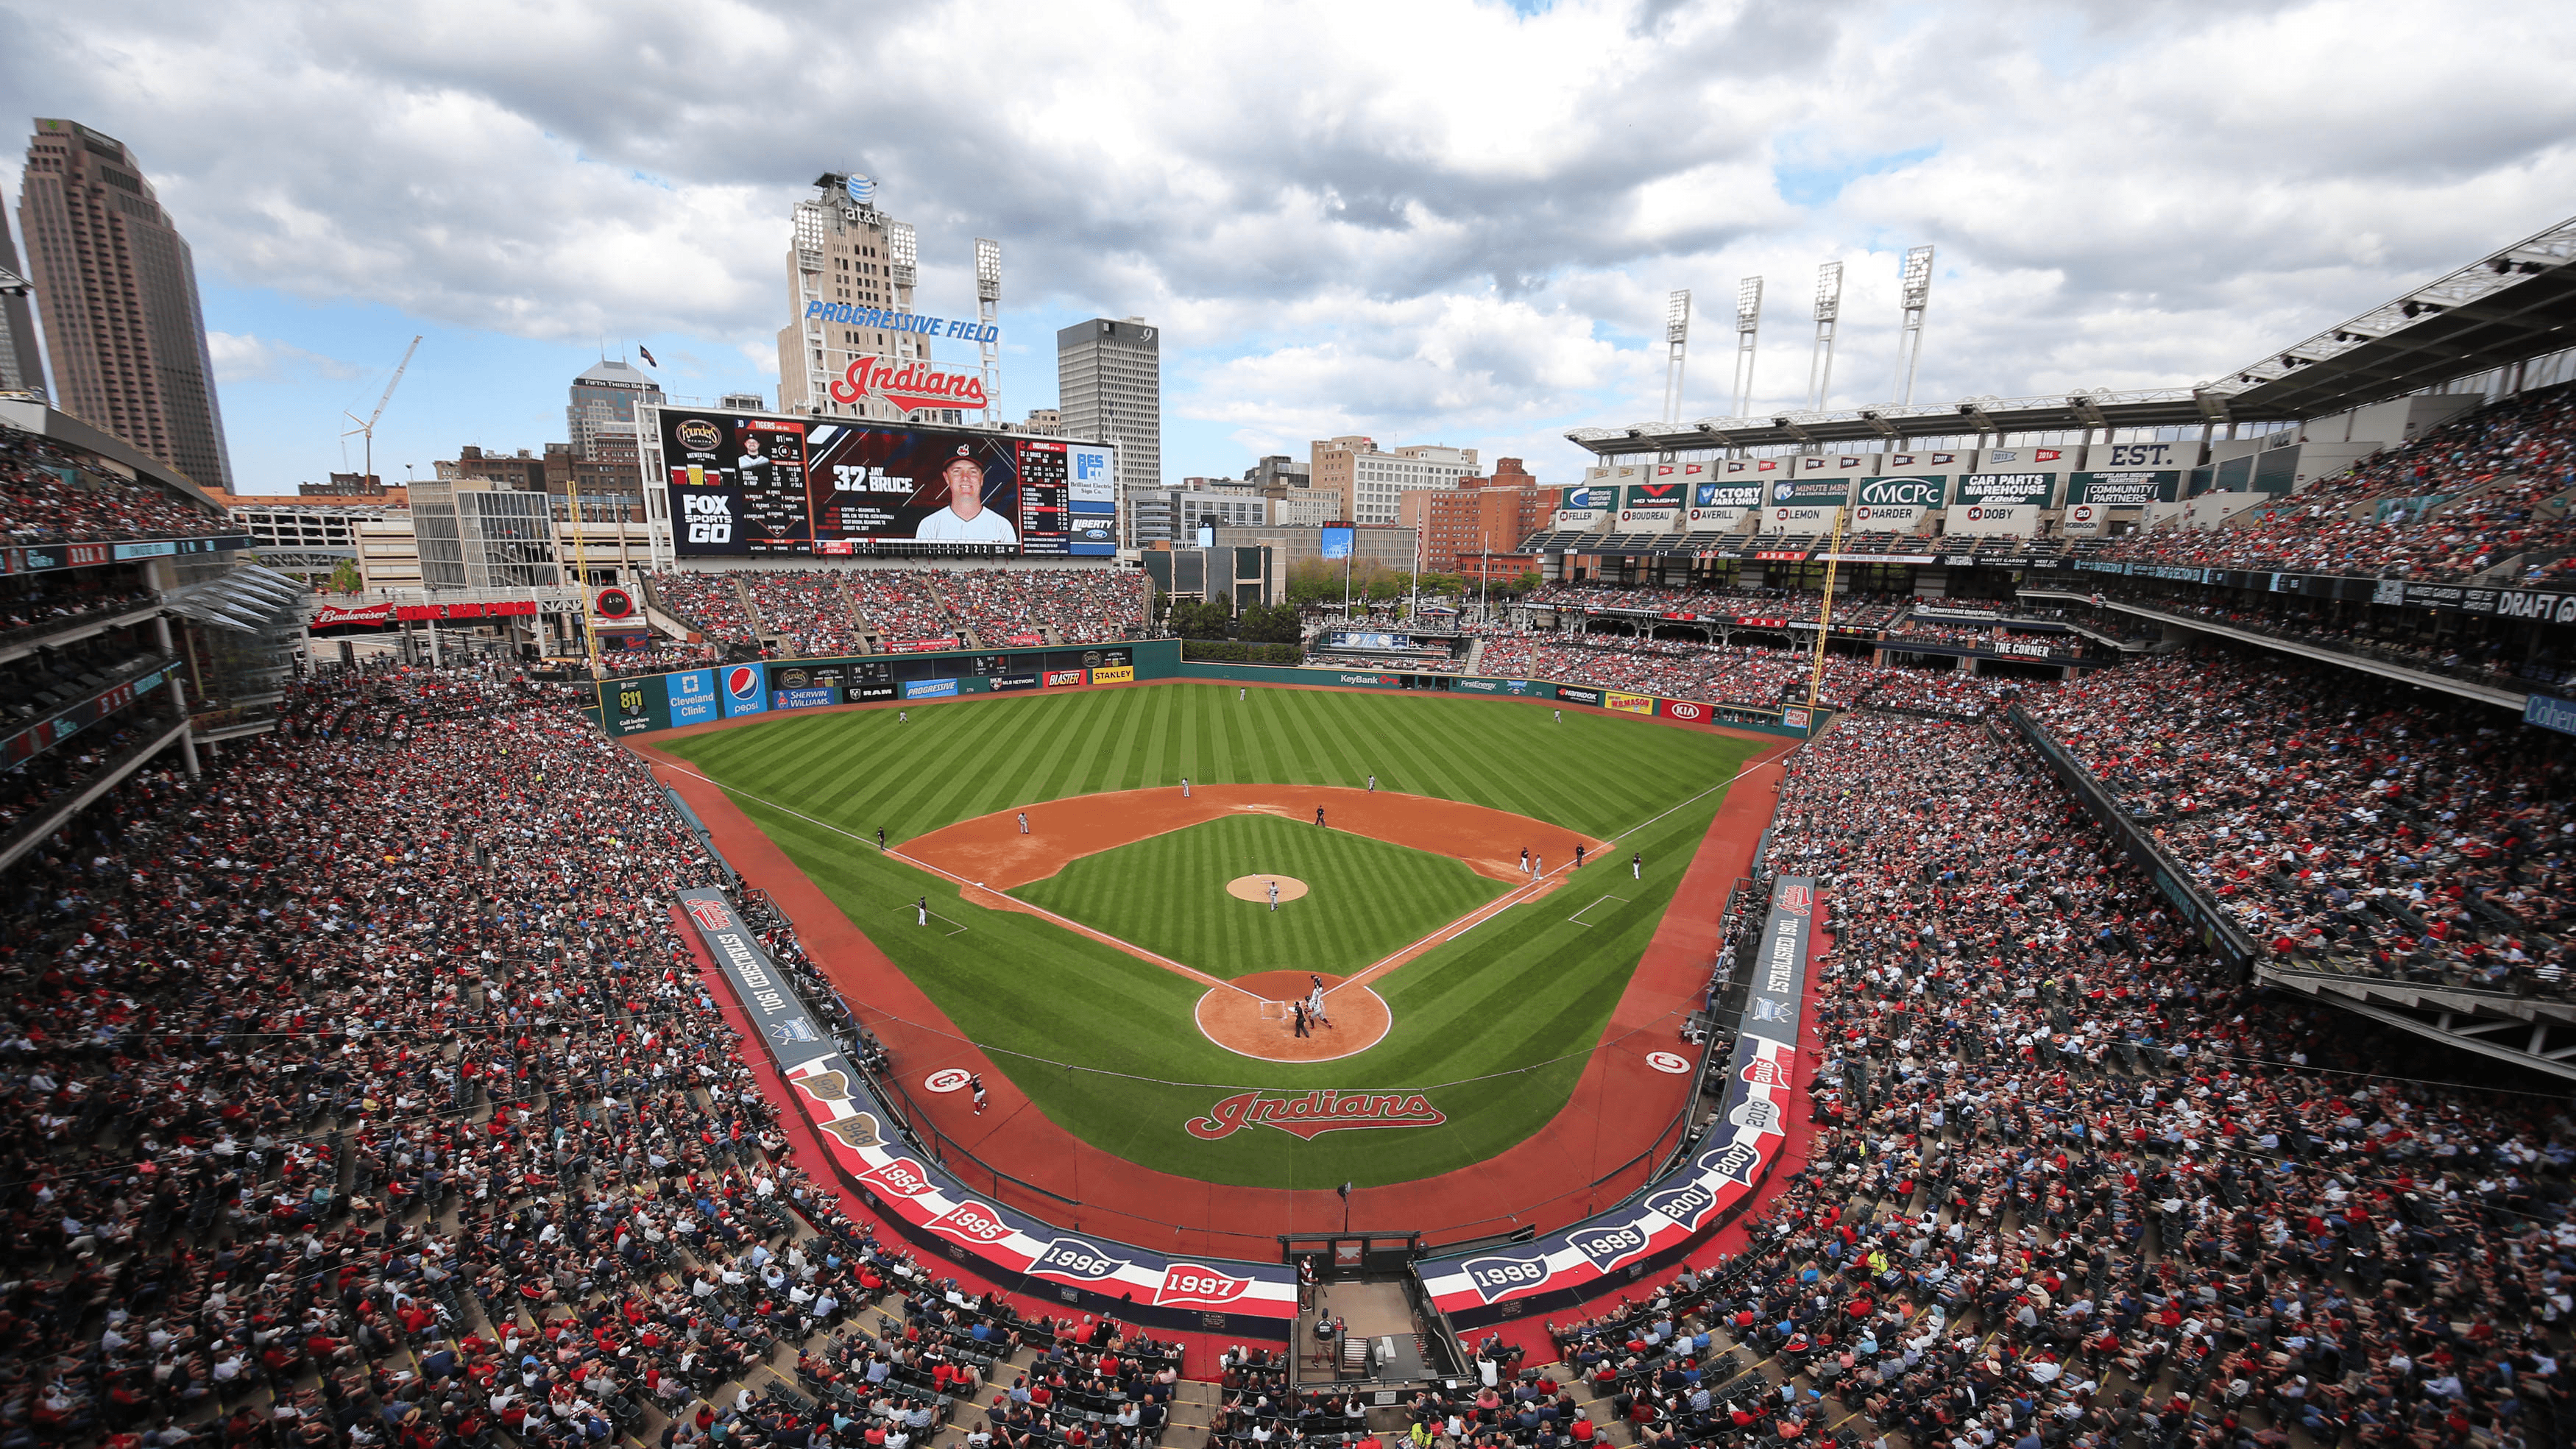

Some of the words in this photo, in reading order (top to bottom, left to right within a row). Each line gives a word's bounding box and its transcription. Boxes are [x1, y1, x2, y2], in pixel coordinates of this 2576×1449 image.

[846, 207, 881, 225] at&t
[805, 300, 944, 336] PROGRESSIVE
[947, 320, 999, 343] FIELD
[1140, 328, 1153, 342] 9
[585, 379, 606, 387] FIFTH
[607, 380, 630, 389] THIRD
[631, 382, 651, 390] BANK
[829, 356, 988, 409] Indians
[755, 421, 775, 429] TIGERS
[2038, 451, 2053, 459] 2016
[2109, 444, 2173, 465] EST.
[1759, 462, 1771, 470] 1997
[833, 465, 867, 492] 32
[868, 467, 883, 476] JAY
[868, 476, 913, 493] BRUCE
[1969, 475, 1997, 485] CAR
[1998, 475, 2044, 485] PARTS
[1964, 485, 2046, 495] WAREHOUSE
[2090, 484, 2153, 495] COMMUNITY
[683, 495, 731, 515] FOX
[1711, 497, 1734, 506] PARK
[2092, 494, 2147, 503] PARTNERS
[685, 515, 732, 523] SPORTS
[1702, 511, 1733, 519] AVERILL
[1789, 510, 1820, 519] LEMON
[1872, 509, 1912, 518] HARDER
[1984, 509, 2014, 519] DOBY
[2077, 509, 2090, 518] 20
[1071, 519, 1114, 531] LIBERTY
[688, 523, 732, 543] GO
[318, 610, 387, 623] Budweiser
[397, 606, 444, 621] HOME
[449, 603, 481, 618] RUN
[485, 601, 537, 617] PORCH
[2432, 588, 2461, 599] GARDEN
[2497, 591, 2558, 619] DRAFT
[2556, 596, 2576, 623] @
[1995, 642, 2010, 654] THE
[2012, 642, 2049, 657] CORNER
[1049, 673, 1080, 687] BLASTER
[1094, 670, 1131, 679] STANLEY
[1340, 675, 1379, 686] KeyBank
[907, 681, 956, 697] PROGRESSIVE
[1461, 680, 1497, 690] FirstEnergy
[620, 690, 643, 709] 811
[670, 692, 714, 707] Cleveland
[790, 691, 827, 699] SHERWIN
[681, 704, 707, 717] Clinic
[734, 701, 759, 714] pepsi
[1676, 706, 1695, 716] KIA
[1787, 711, 1804, 720] drug
[1787, 718, 1807, 726] mart
[685, 899, 733, 930] Indians
[717, 933, 771, 988] ESTABLISHED
[1767, 937, 1796, 993] ESTABLISHED
[1653, 1055, 1682, 1069] C
[1754, 1060, 1774, 1083] 2016
[812, 1074, 841, 1098] 1920
[1184, 1090, 1447, 1141] Indians
[1745, 1101, 1770, 1127] 2013
[838, 1116, 874, 1145] 1948
[1712, 1144, 1755, 1175] 2007
[878, 1163, 924, 1194] 1954
[1660, 1190, 1712, 1218] 2001
[946, 1208, 999, 1239] 1995
[1579, 1228, 1641, 1258] 1999
[1043, 1247, 1110, 1277] 1996
[1473, 1264, 1542, 1287] 1998
[1167, 1274, 1236, 1297] 1997
